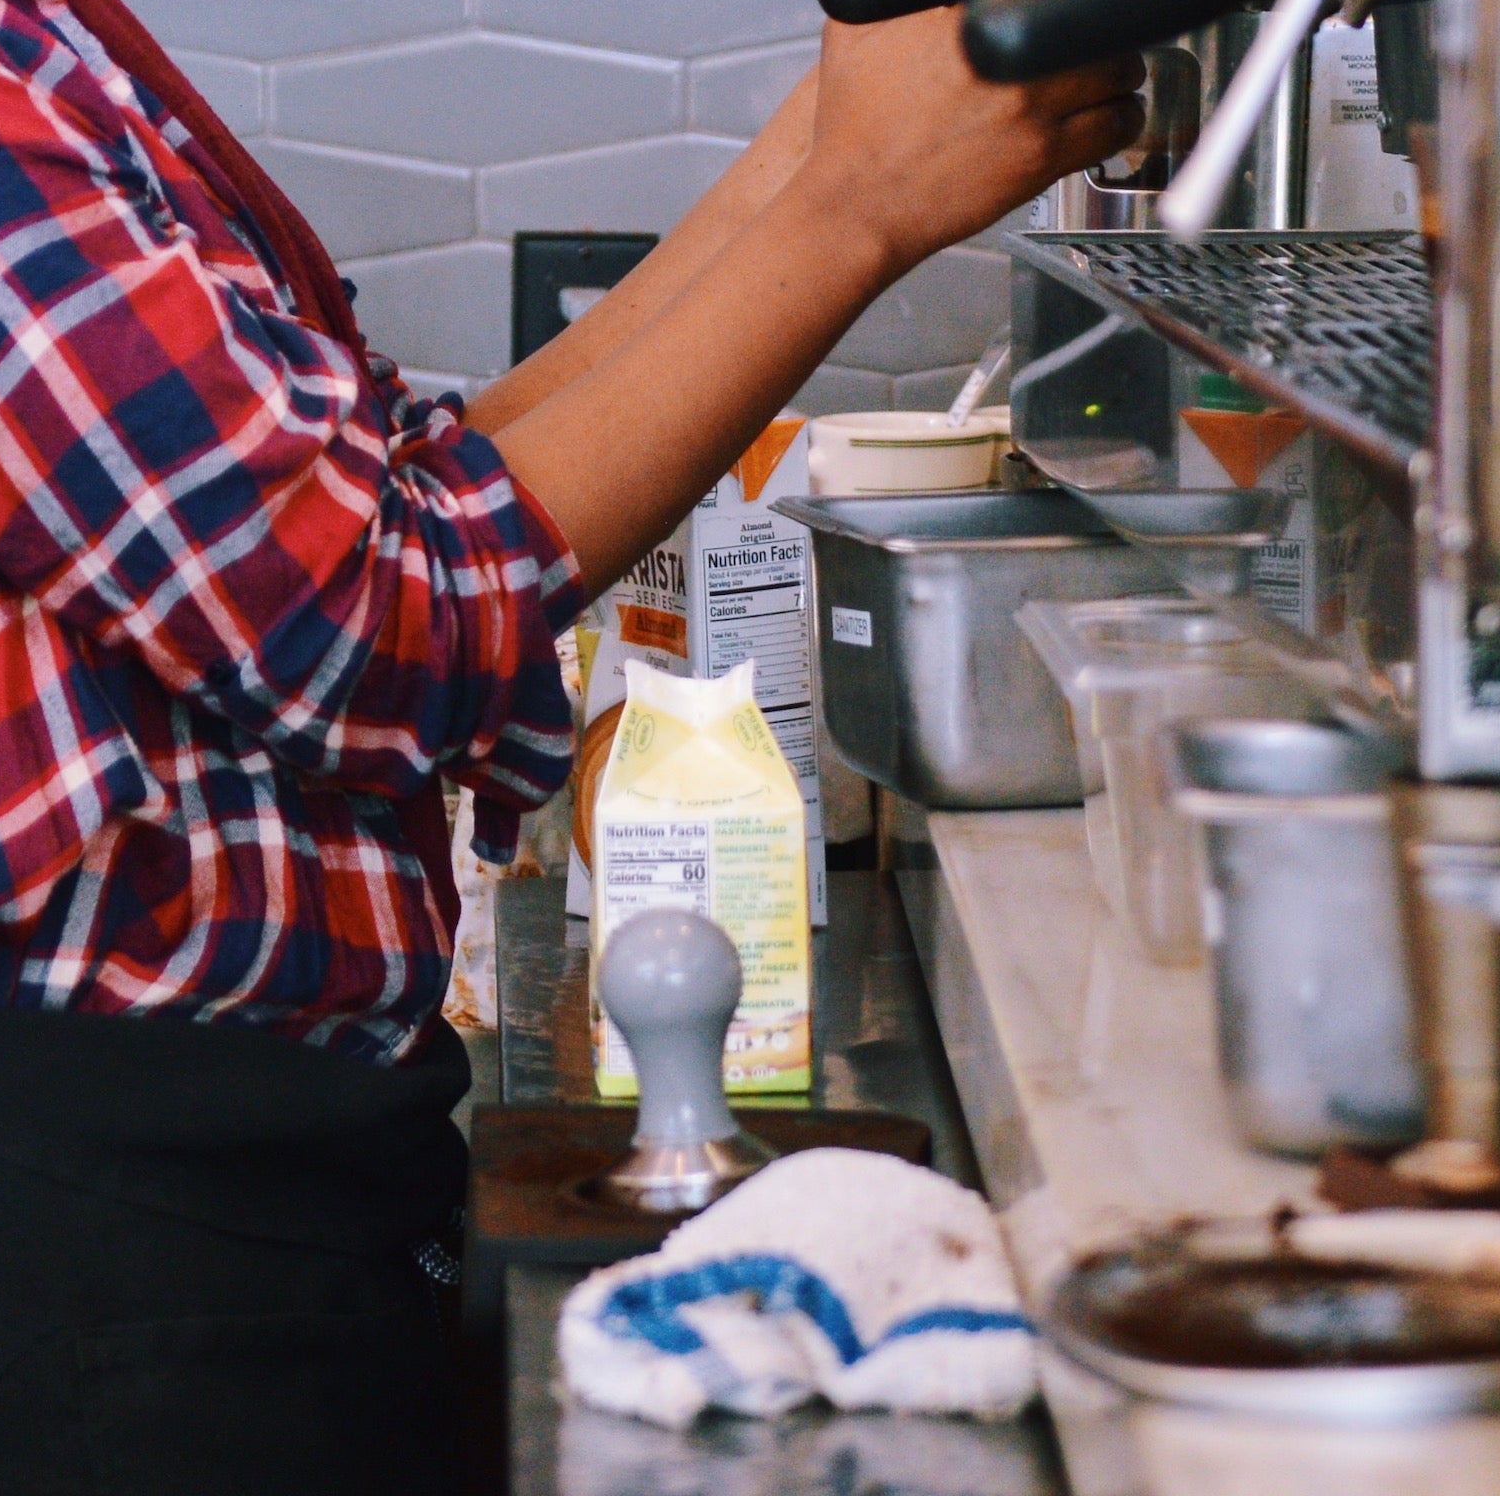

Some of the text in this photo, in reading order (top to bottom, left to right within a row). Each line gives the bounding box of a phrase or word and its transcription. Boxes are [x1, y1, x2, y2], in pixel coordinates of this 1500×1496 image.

[740, 520, 773, 533] Almond
[739, 531, 776, 545] Original
[707, 543, 804, 569] Nutrition Facts
[635, 590, 673, 610] SERIES
[709, 603, 748, 618] Calories
[834, 613, 868, 637] SANITIZER
[606, 823, 706, 838] Nutrition Facts
[714, 825, 787, 835] PASTEURIZED
[607, 863, 706, 883] Calories 60
